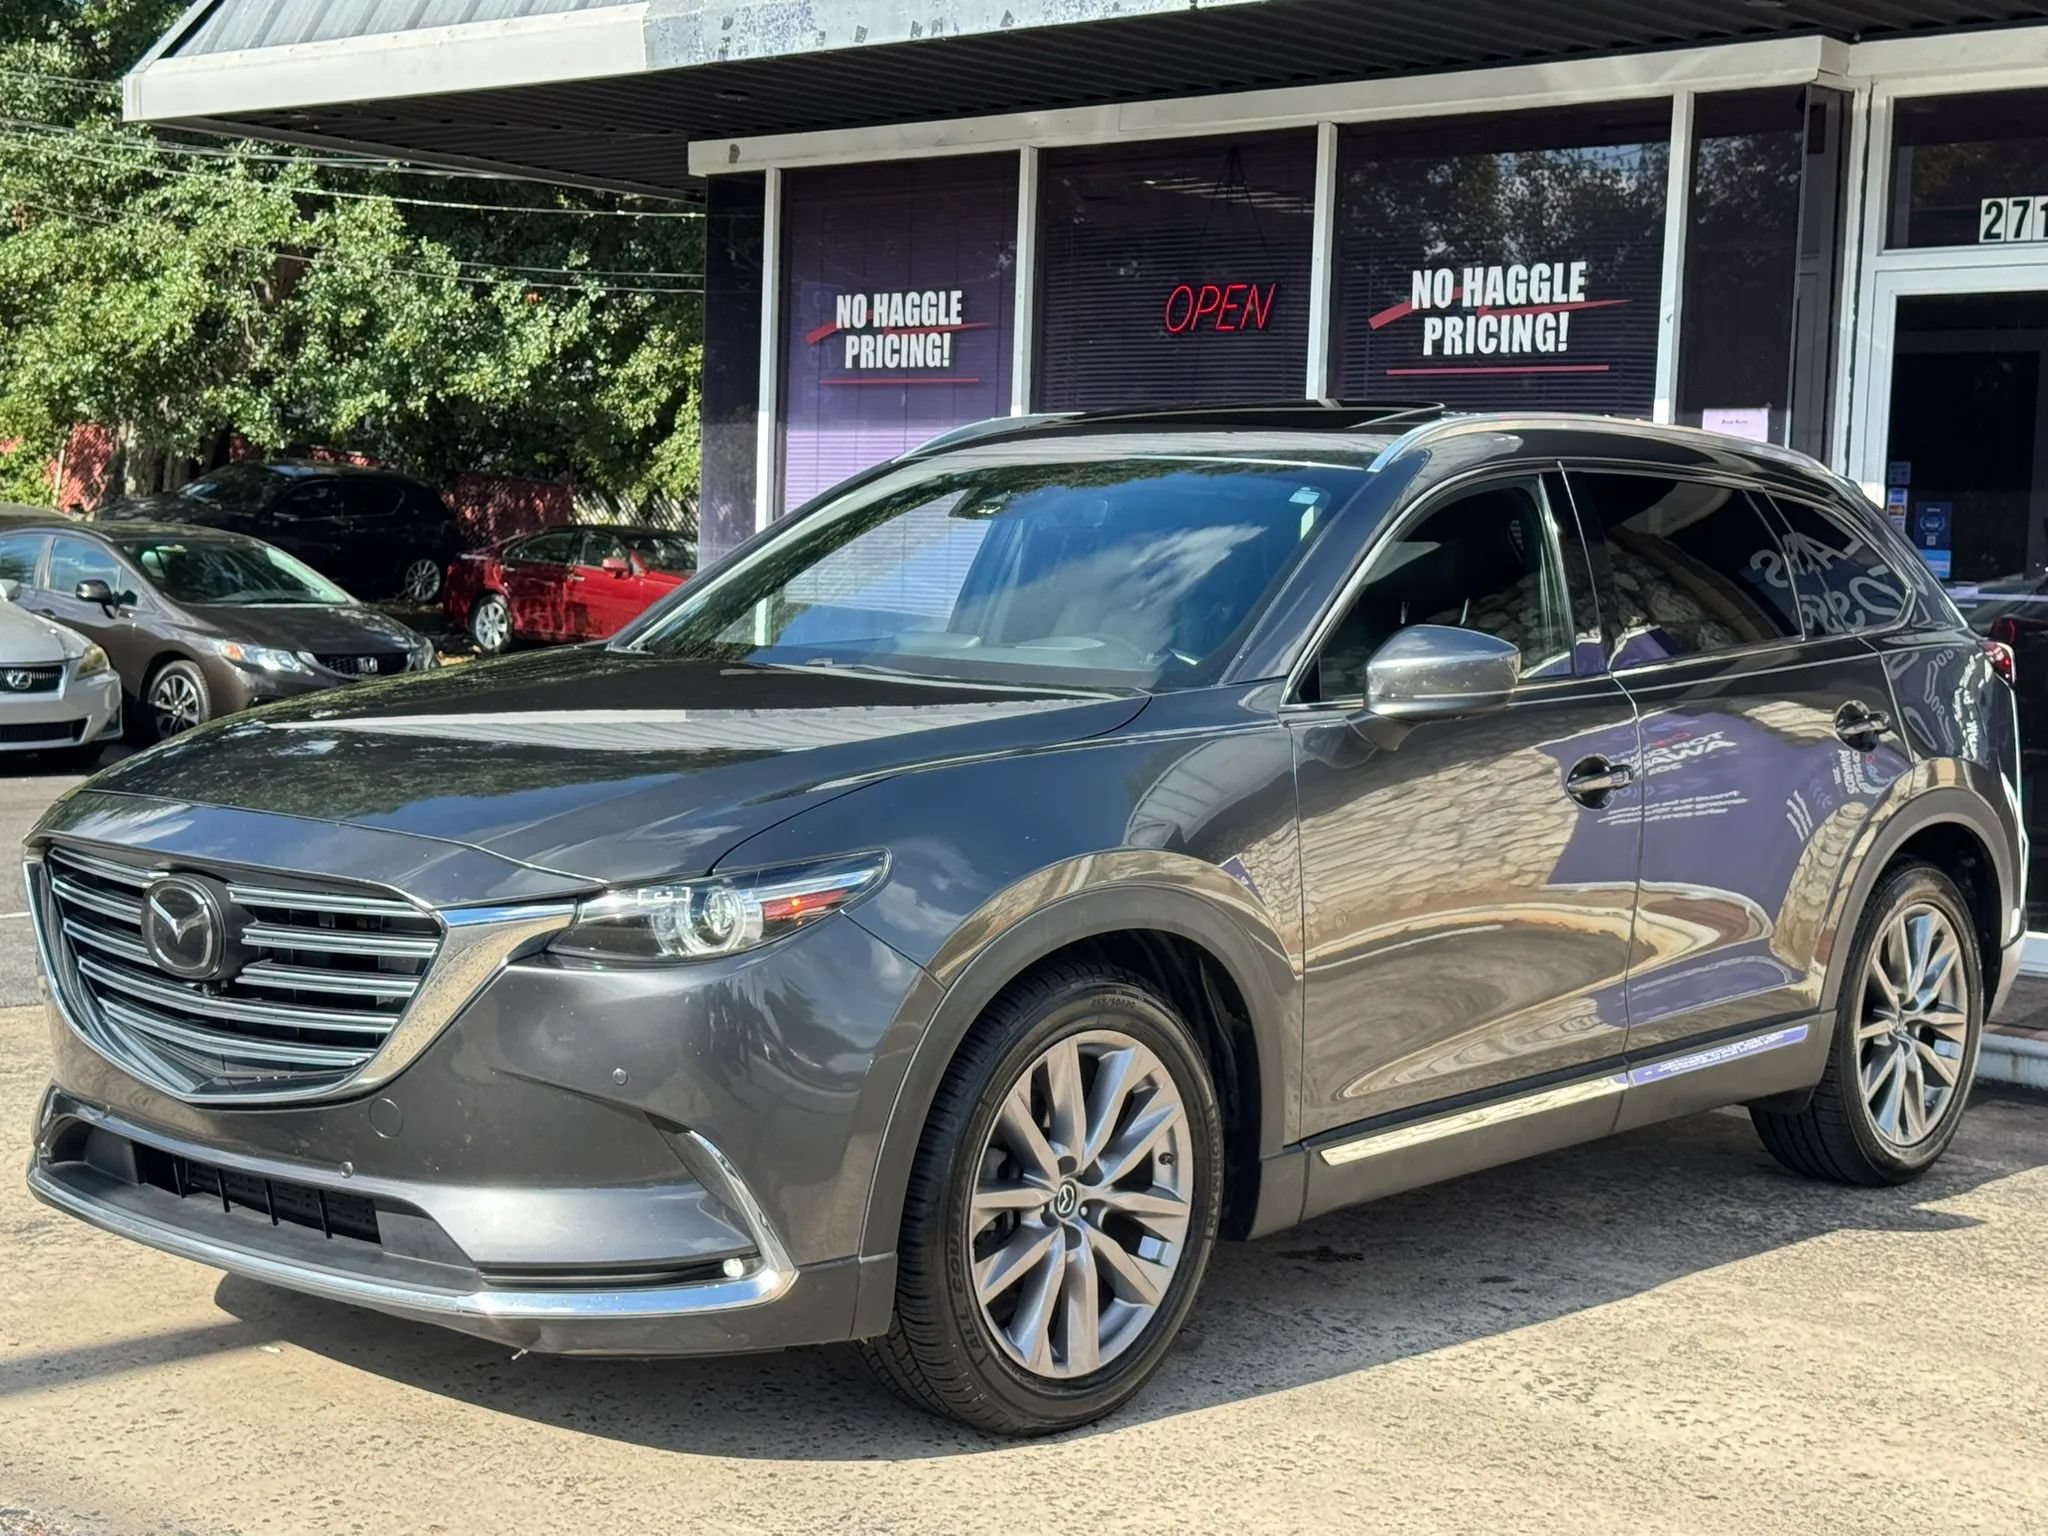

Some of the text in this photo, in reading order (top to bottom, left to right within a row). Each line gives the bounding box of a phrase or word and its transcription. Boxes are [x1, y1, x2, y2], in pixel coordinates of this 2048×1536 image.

[1412, 261, 1587, 309] NO HAGGLE
[836, 290, 962, 329] NO HAGGLE
[1166, 283, 1276, 333] OPEN
[845, 332, 951, 369] PRICING!
[1423, 312, 1569, 355] PRICING!
